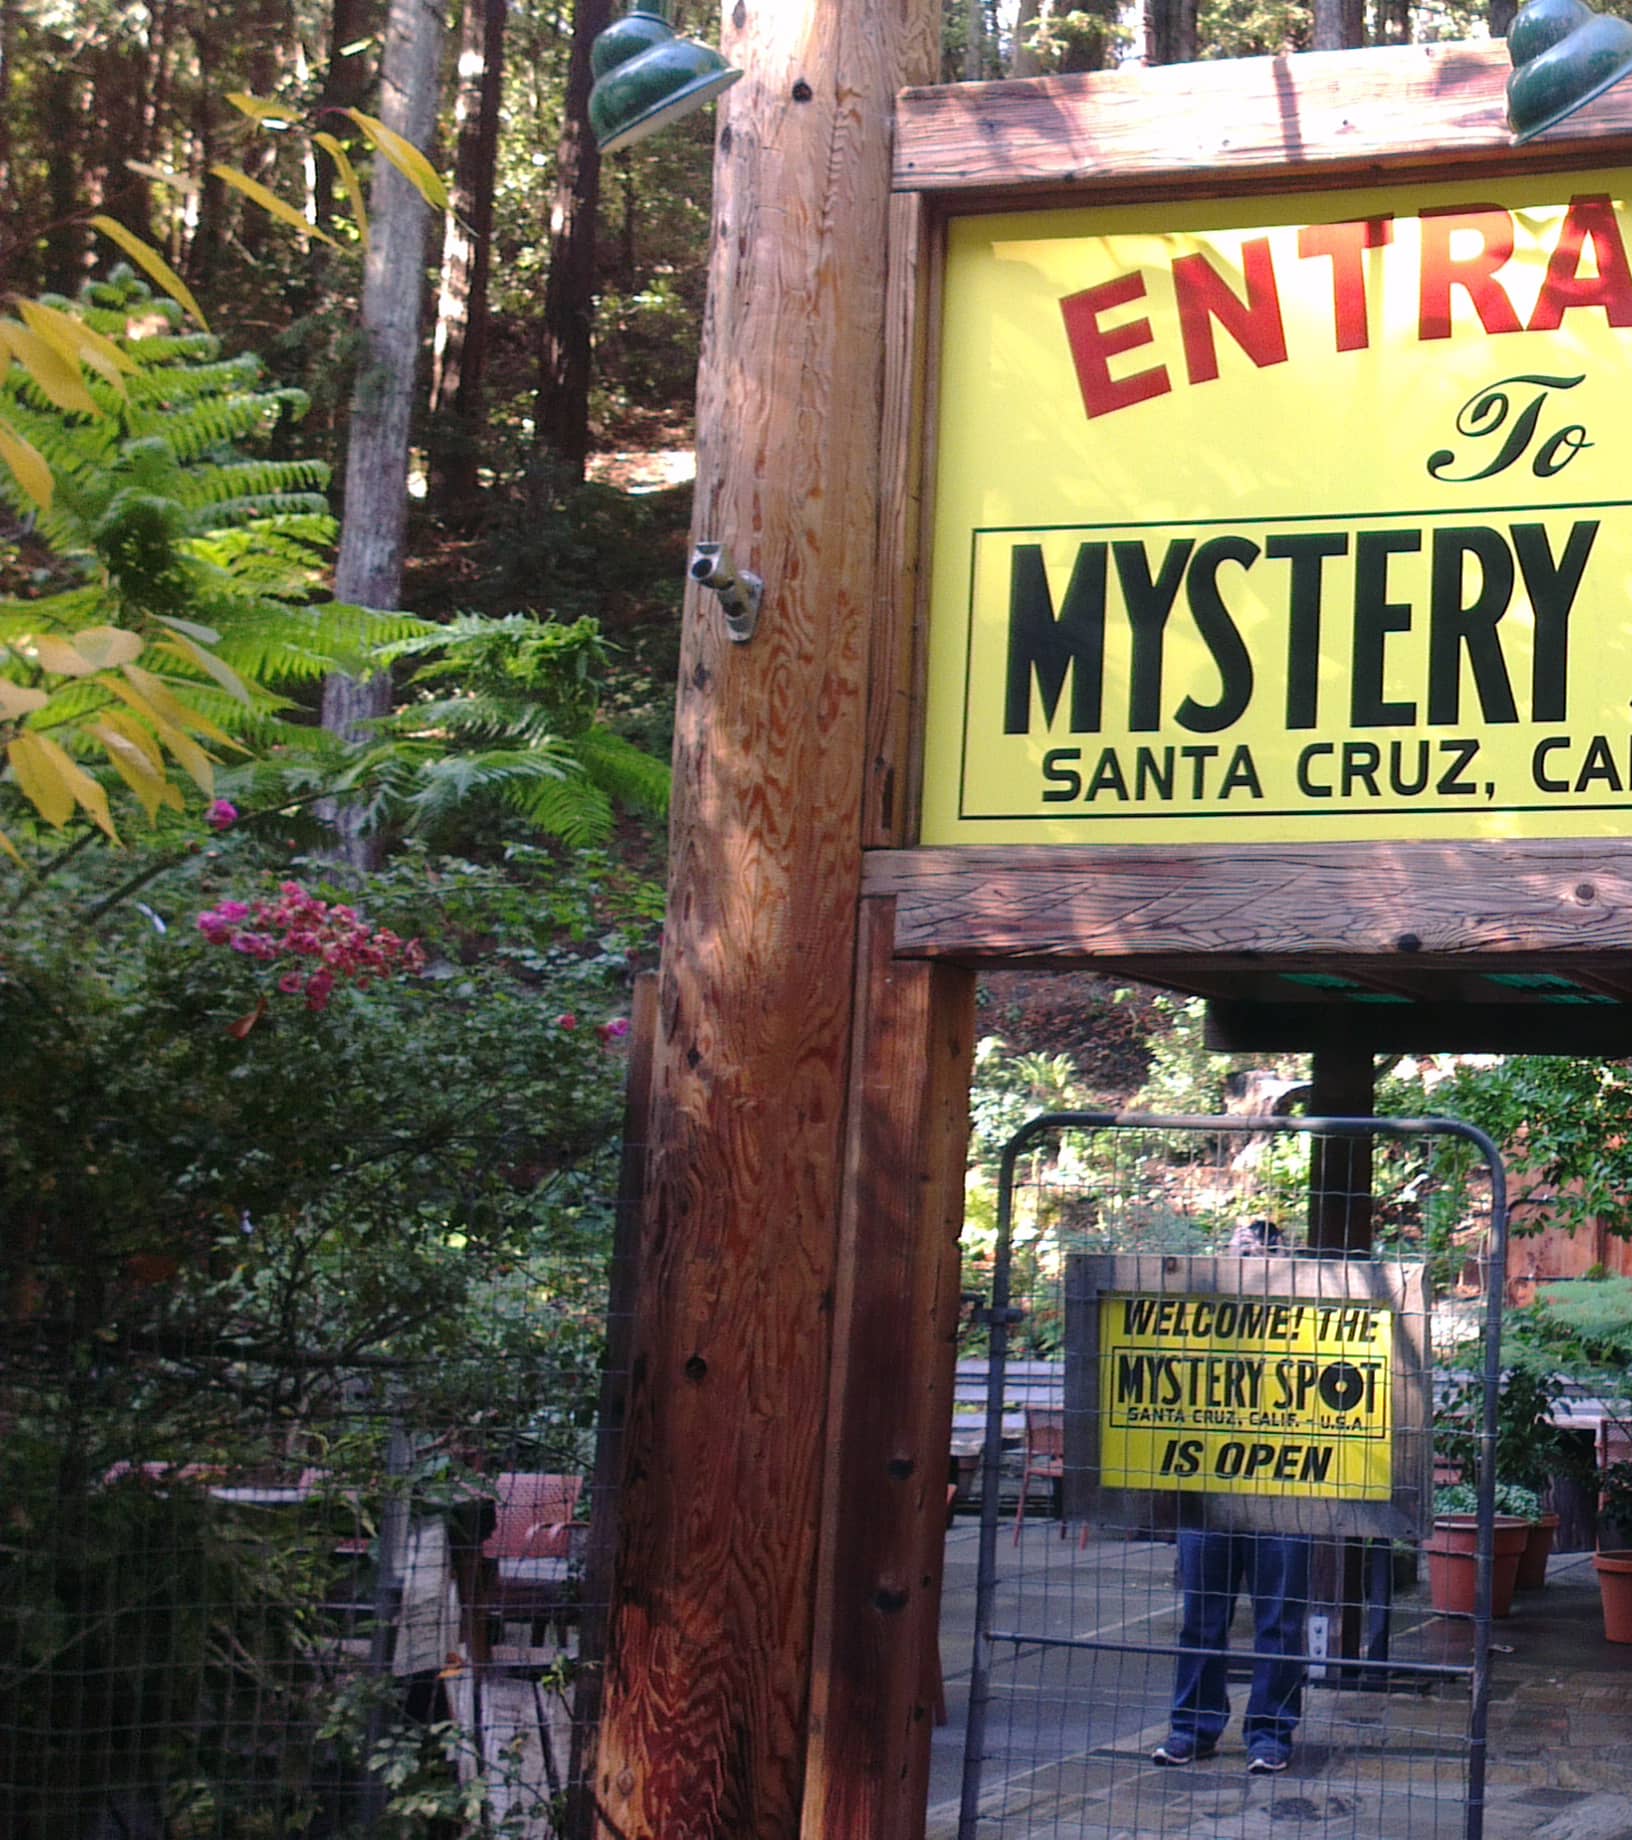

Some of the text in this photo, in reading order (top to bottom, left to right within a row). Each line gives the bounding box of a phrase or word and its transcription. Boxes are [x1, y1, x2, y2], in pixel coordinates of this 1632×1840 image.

[1427, 373, 1595, 482] To
[1003, 521, 1599, 735] MYSTERY
[1041, 745, 1264, 802] SANTA
[1297, 739, 1496, 801] CRUZ,
[1124, 1300, 1380, 1342] WELCOME! THE
[1118, 1355, 1381, 1413] MYSTERY SPOT
[1127, 1407, 1185, 1423] SANTA
[1192, 1409, 1243, 1426] CRUZ,
[1249, 1411, 1300, 1428] CALIF.
[1159, 1440, 1333, 1482] IS OPEN
